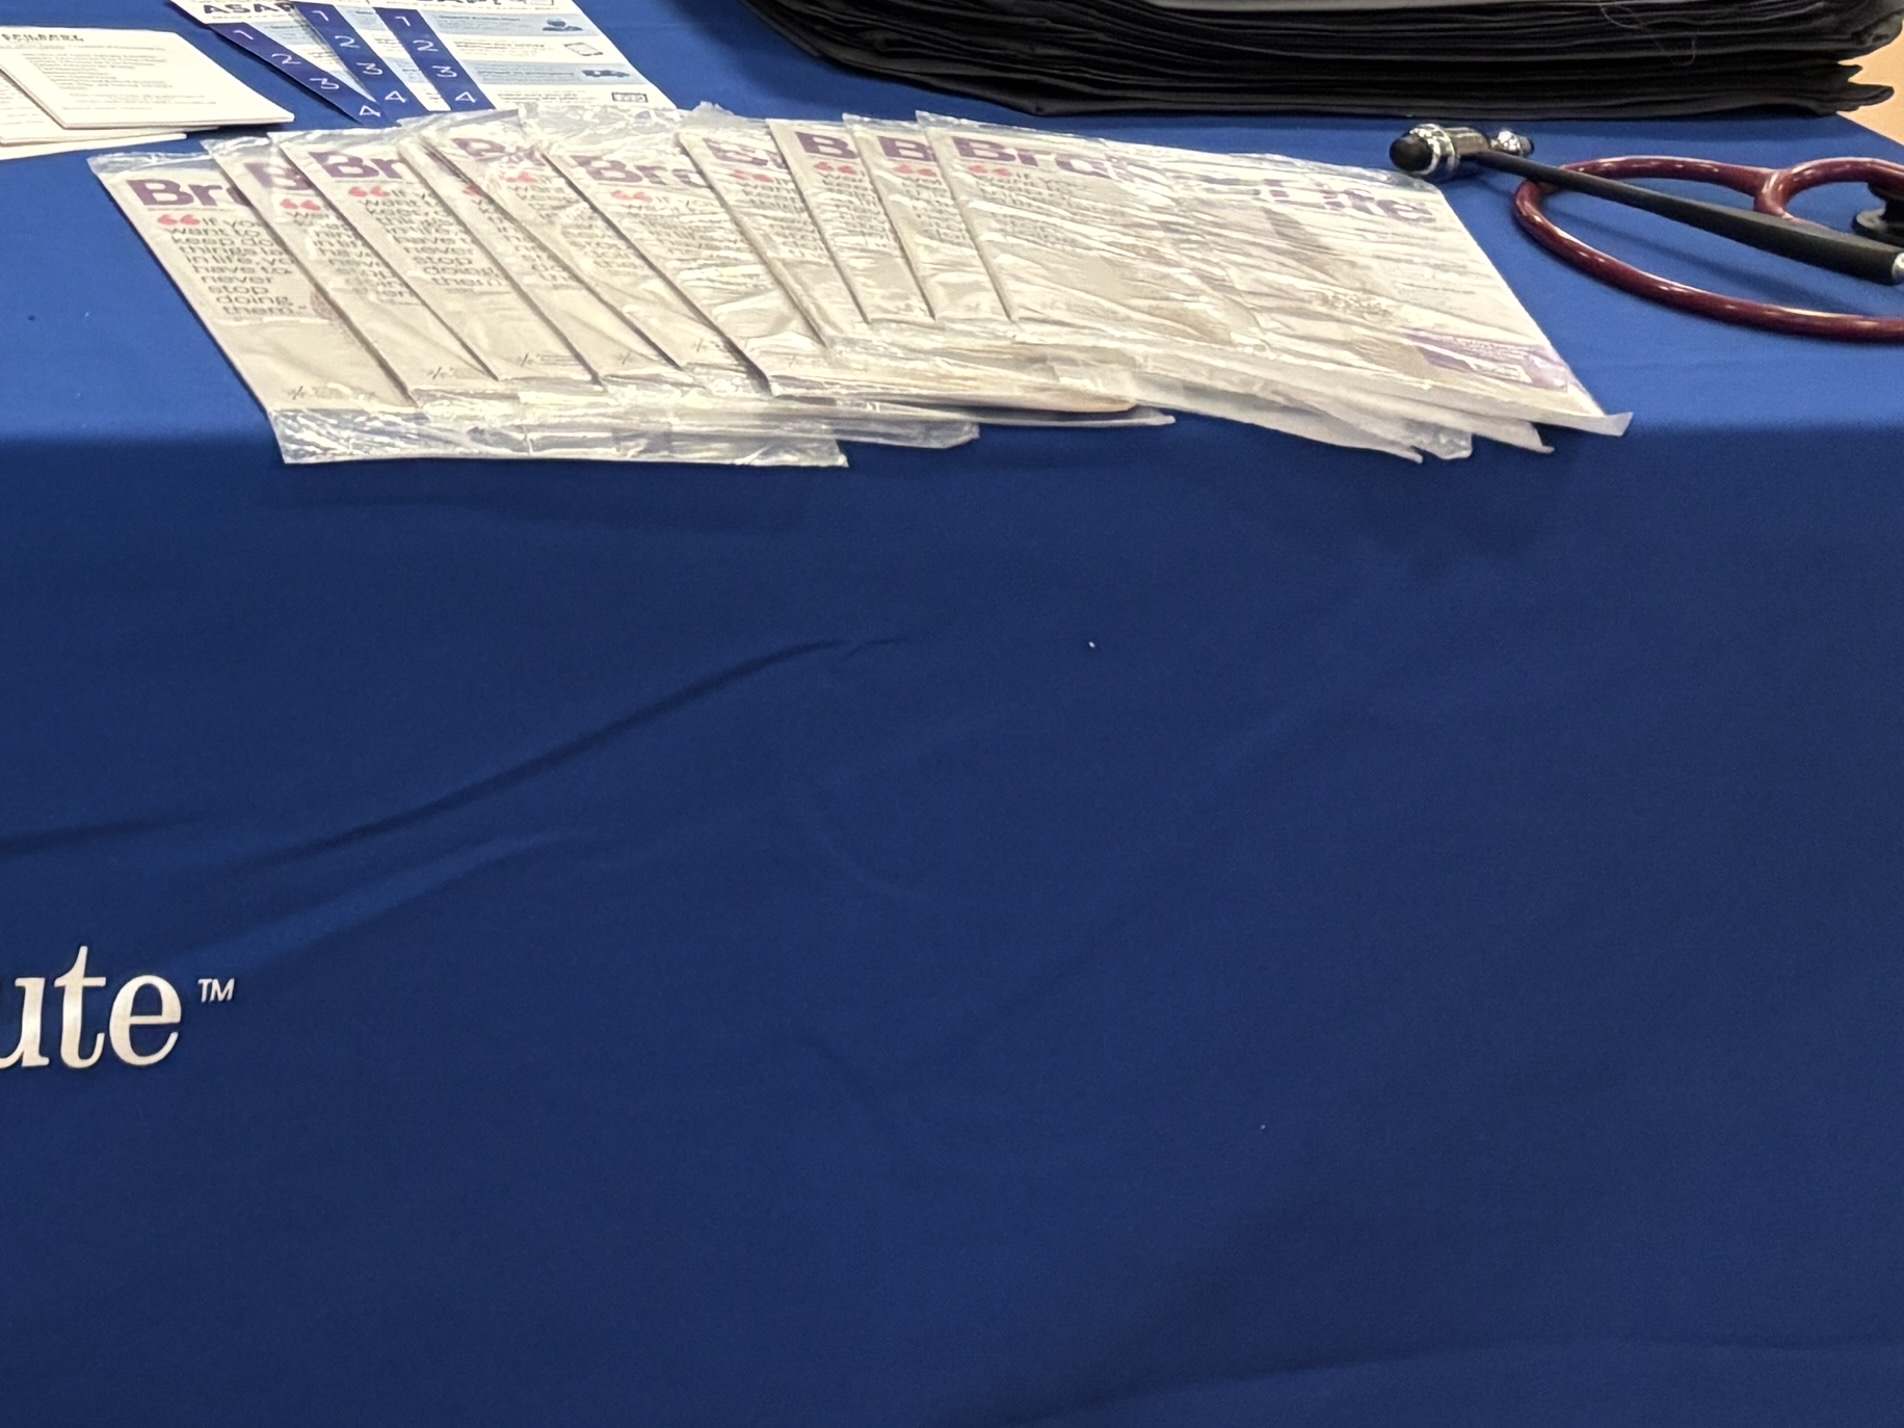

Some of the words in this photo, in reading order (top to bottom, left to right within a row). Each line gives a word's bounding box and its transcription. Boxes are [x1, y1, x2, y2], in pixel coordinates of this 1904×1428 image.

[312, 10, 330, 22] 1
[394, 15, 412, 27] 1
[233, 29, 255, 41] 1
[334, 34, 360, 49] 2
[412, 39, 439, 52] 2
[271, 53, 302, 65] 2
[355, 62, 384, 76] 3
[431, 64, 458, 78] 3
[309, 77, 340, 90] 3
[384, 89, 407, 104] 4
[454, 90, 478, 104] 4
[358, 104, 382, 118] 4
[170, 235, 235, 247] keep
[200, 274, 273, 285] never
[207, 284, 270, 296] stop
[215, 294, 295, 307] doing
